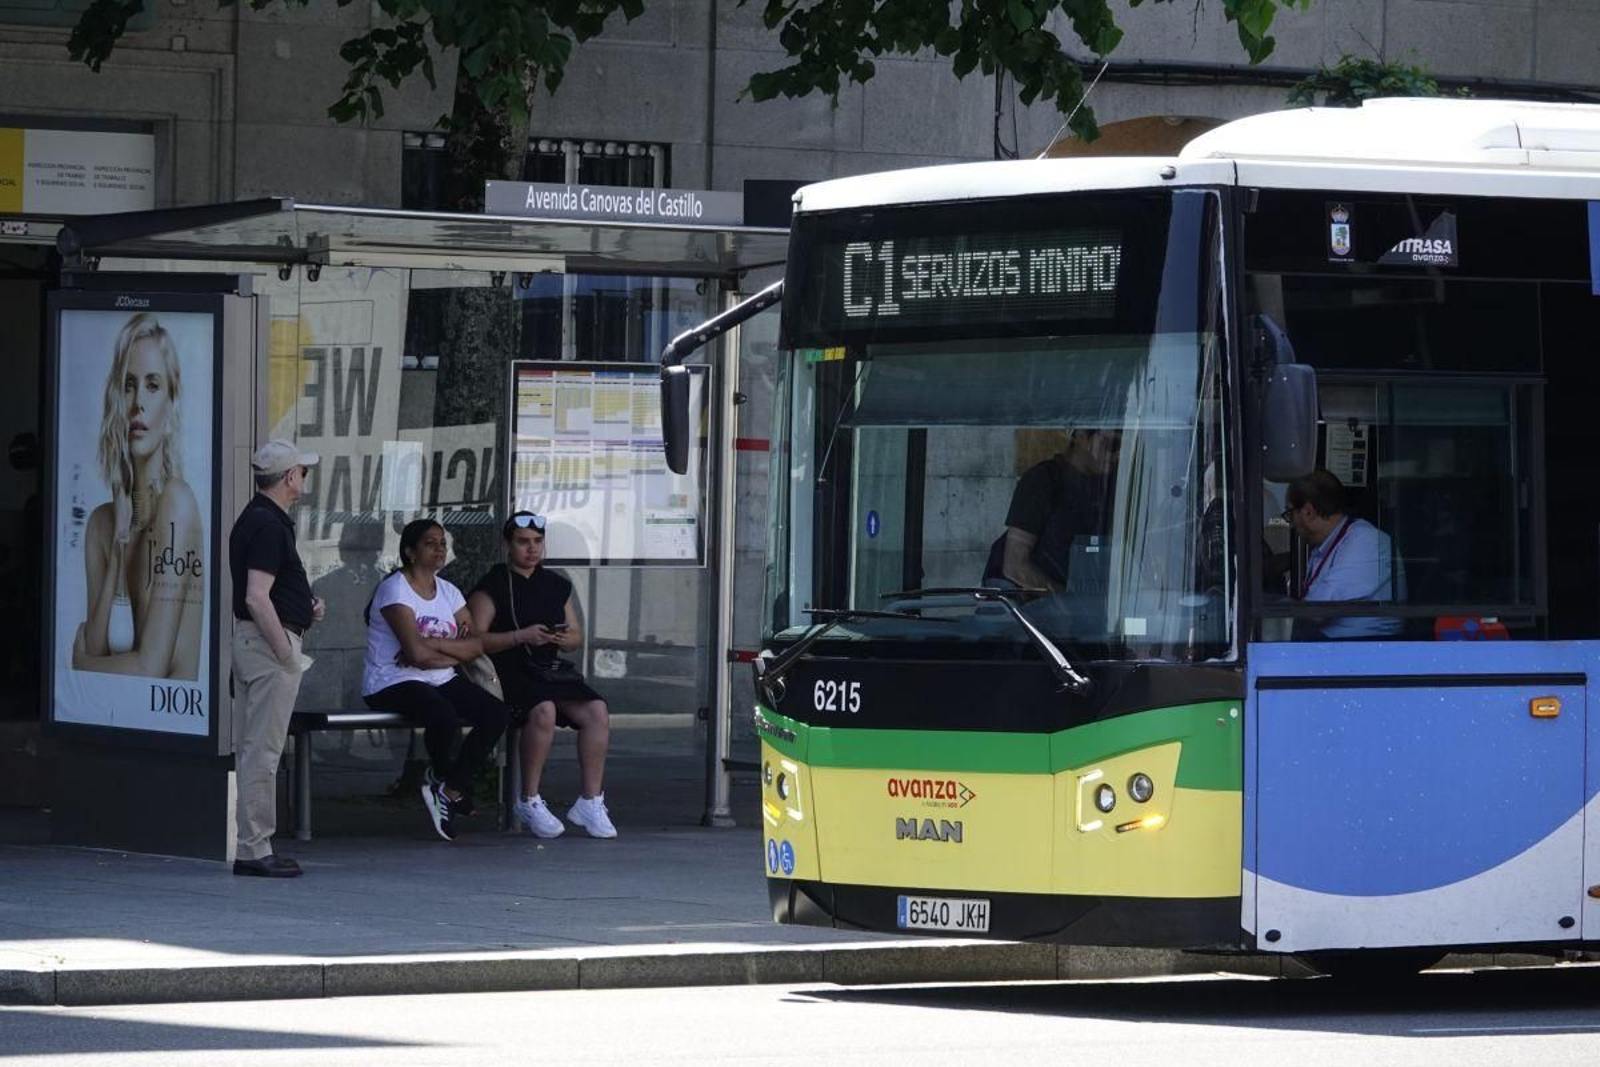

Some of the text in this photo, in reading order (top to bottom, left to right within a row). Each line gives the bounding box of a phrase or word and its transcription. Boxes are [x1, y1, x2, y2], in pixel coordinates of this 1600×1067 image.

[526, 184, 703, 218] Avenida Canovas del Castillo
[1412, 253, 1444, 262] avanza
[844, 240, 1121, 317] C1 SERVIZOS MINIMO
[114, 296, 149, 306] JCDecaux
[149, 684, 205, 718] DIOR
[813, 679, 861, 713] 6215
[888, 778, 956, 799] avanza
[896, 817, 962, 843] MAN
[909, 899, 950, 927] 6540
[956, 902, 987, 929] JKH
